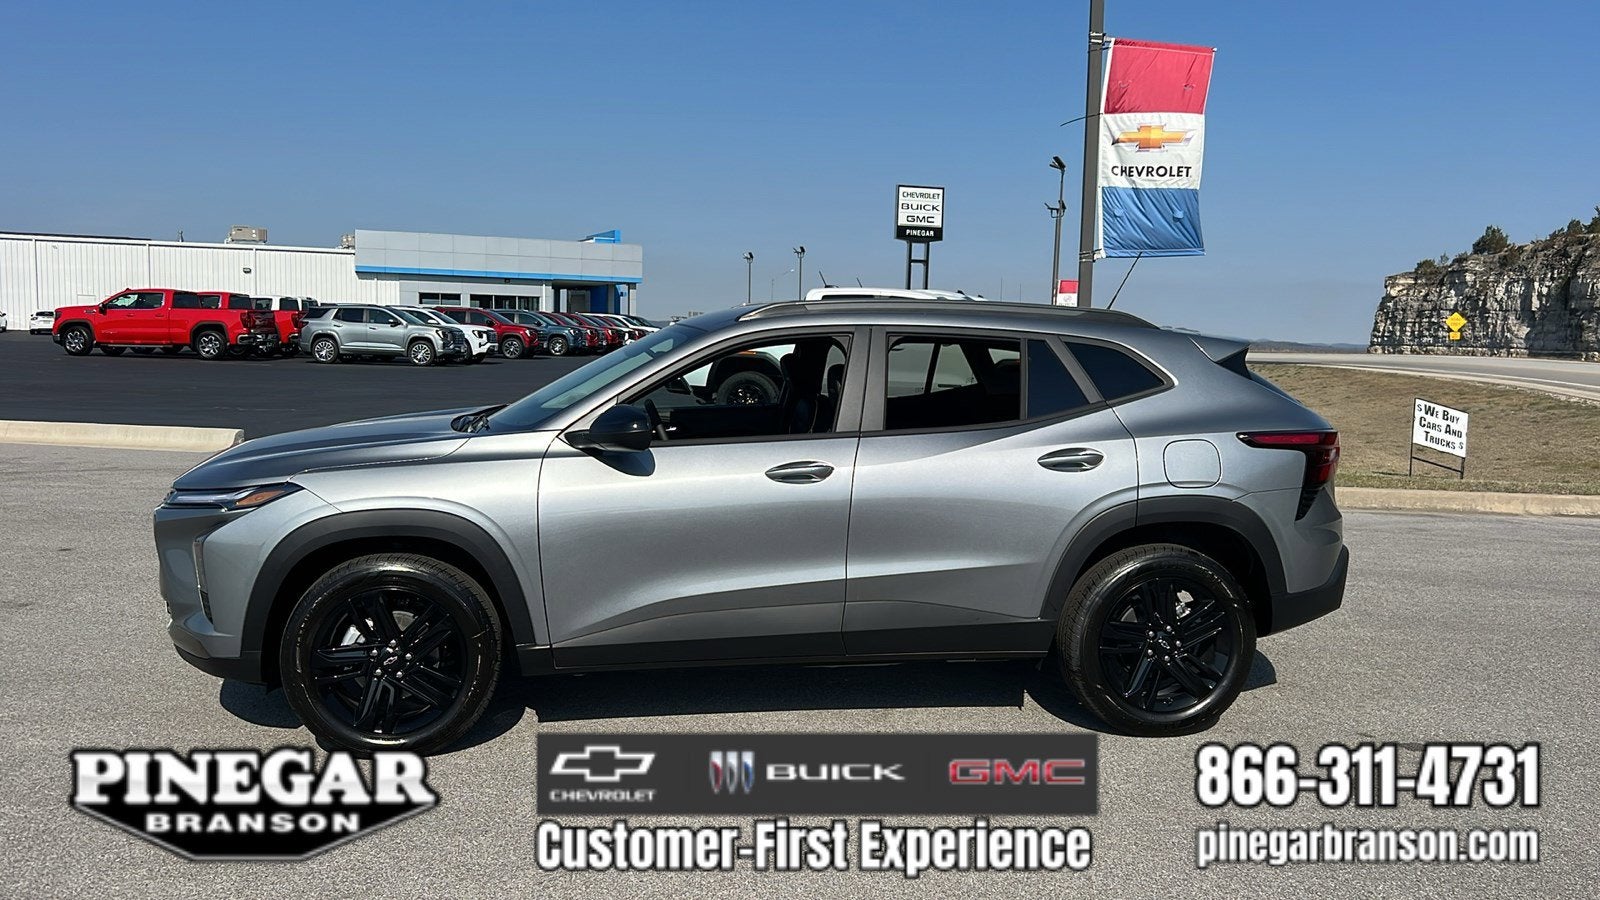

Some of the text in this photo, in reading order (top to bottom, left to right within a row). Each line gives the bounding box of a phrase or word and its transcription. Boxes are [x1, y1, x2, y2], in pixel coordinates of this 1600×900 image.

[1111, 165, 1192, 178] CHEVROLET
[902, 191, 941, 200] CHEVROLET
[901, 203, 940, 212] BUICK
[906, 215, 935, 224] GMC
[906, 229, 935, 237] PINEGAR
